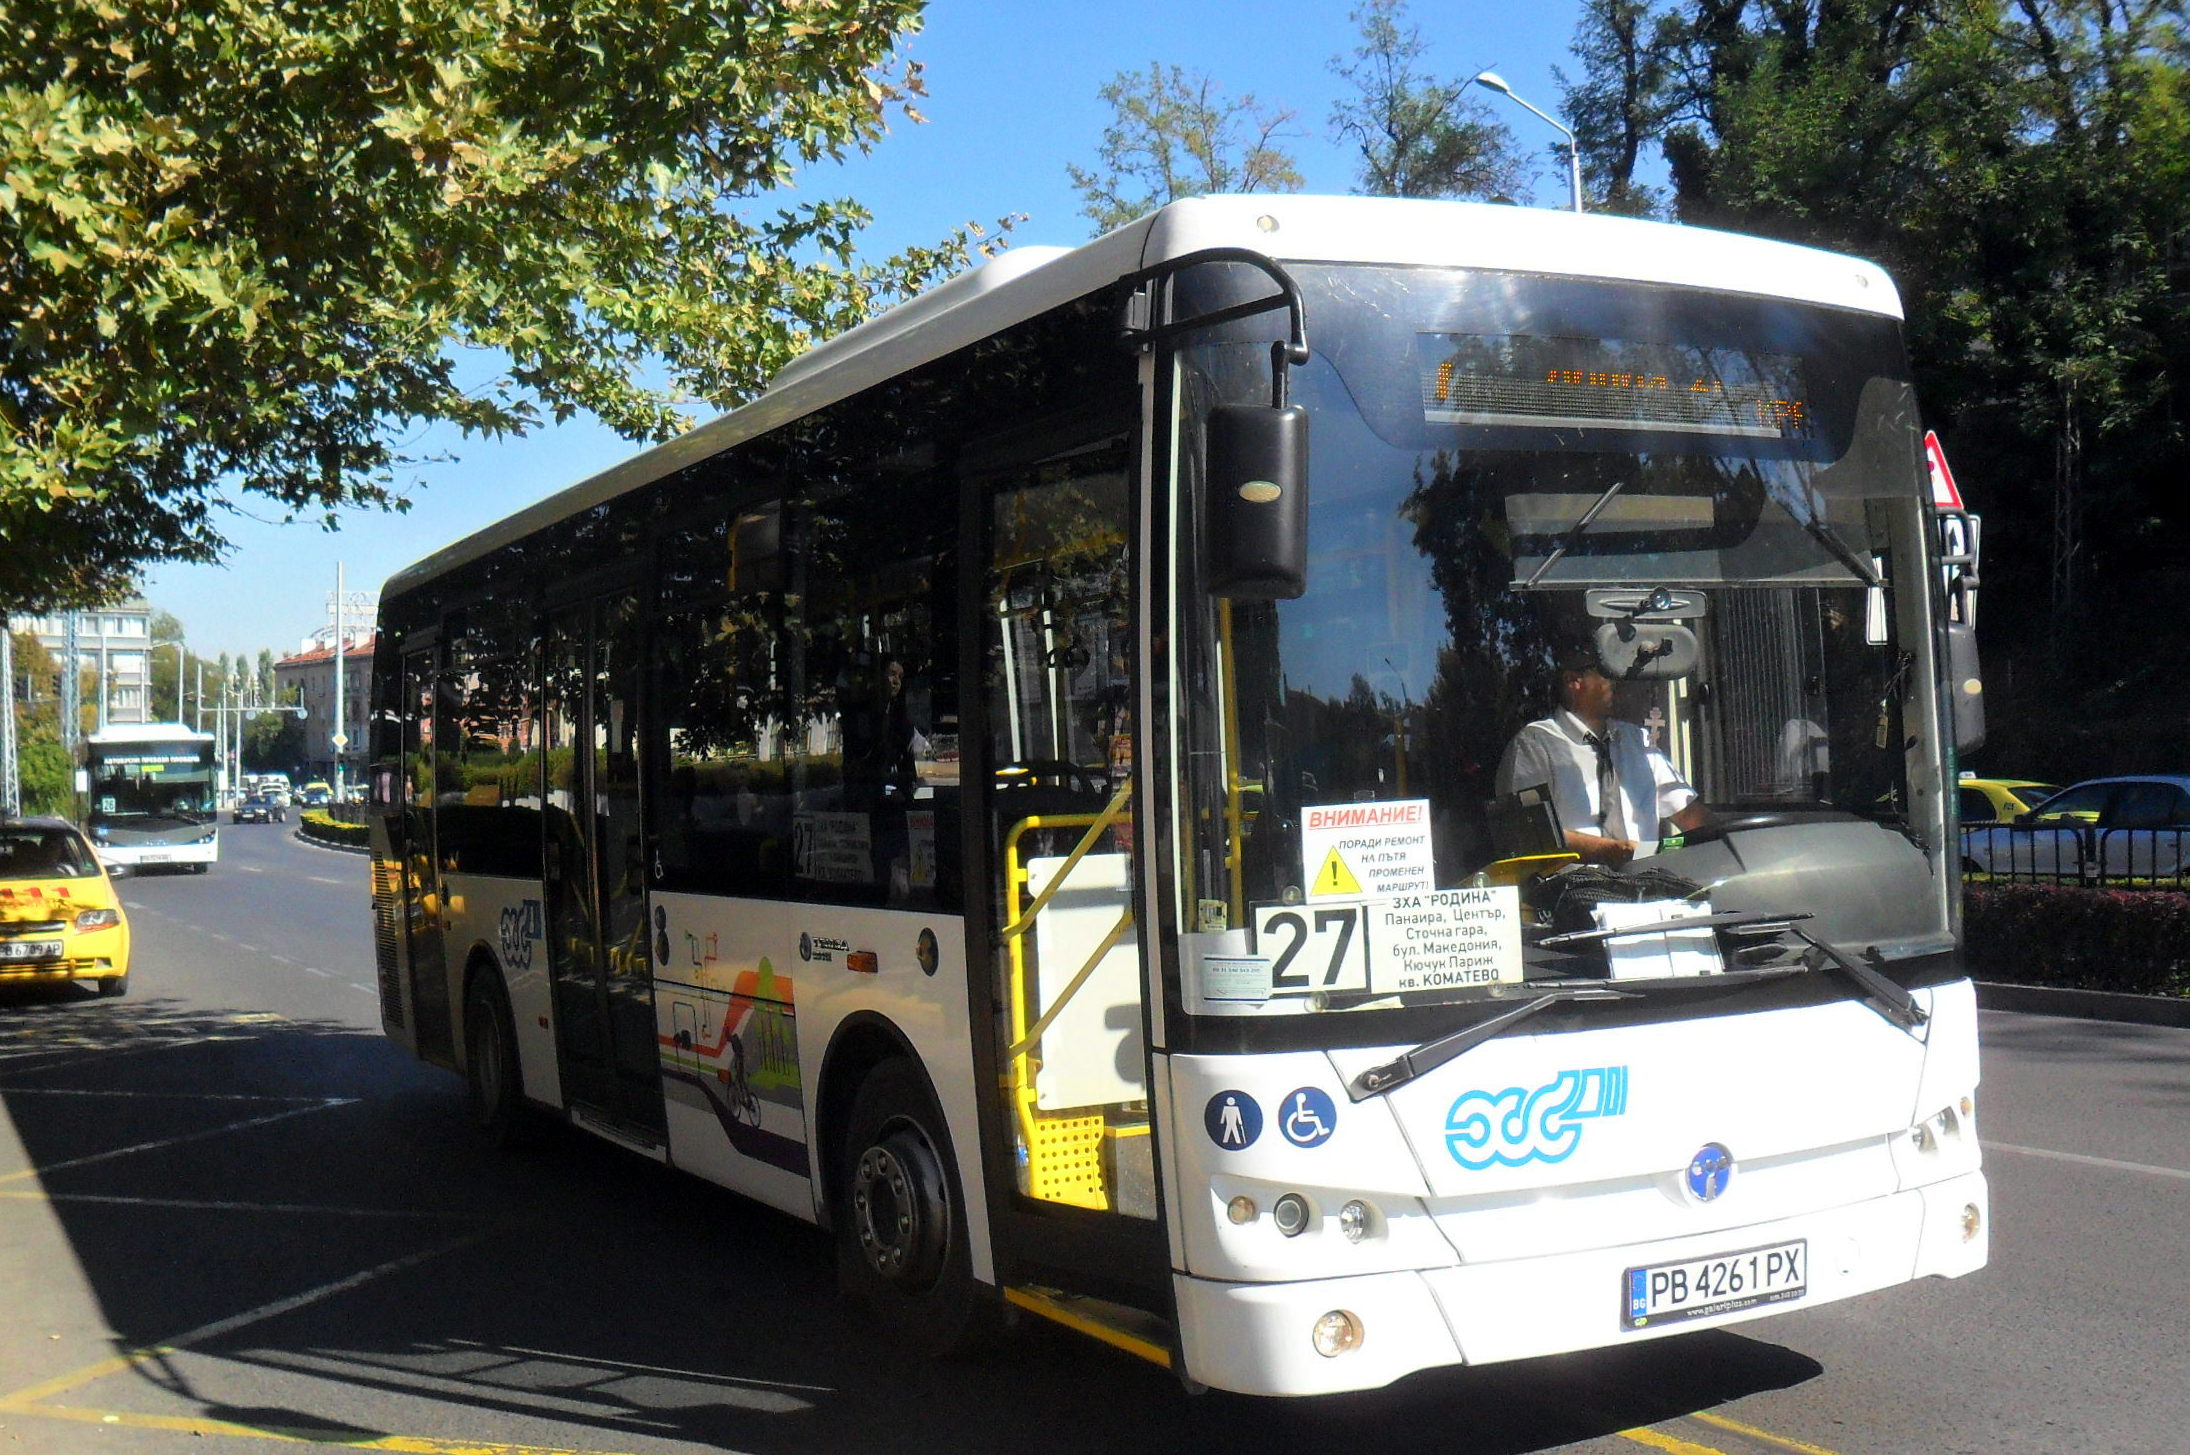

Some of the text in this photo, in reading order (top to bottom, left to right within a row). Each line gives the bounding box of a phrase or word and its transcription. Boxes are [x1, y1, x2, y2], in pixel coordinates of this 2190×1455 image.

[1309, 805, 1422, 828] ВНИМАНИЕ!
[1339, 835, 1425, 850] ПОРАДИ РЕМОНТ
[1361, 852, 1406, 864] НА ПЪТЯ
[1368, 866, 1424, 878] ПРОМЕНЕН
[1376, 881, 1429, 893] МАРШРУТ!
[1393, 889, 1496, 909] ЗХА "РОДИНА"
[1385, 908, 1506, 926] Панаира, Център,
[1406, 925, 1488, 940] Сточна гара,
[1263, 908, 1357, 989] 27
[1393, 939, 1502, 958] бул. Македония,
[1404, 955, 1493, 973] Кючук Париж
[1399, 968, 1499, 989] кв. КОМАТЕВО
[1651, 1248, 1800, 1308] PB 4261 PX
[1633, 1298, 1646, 1311] BG
